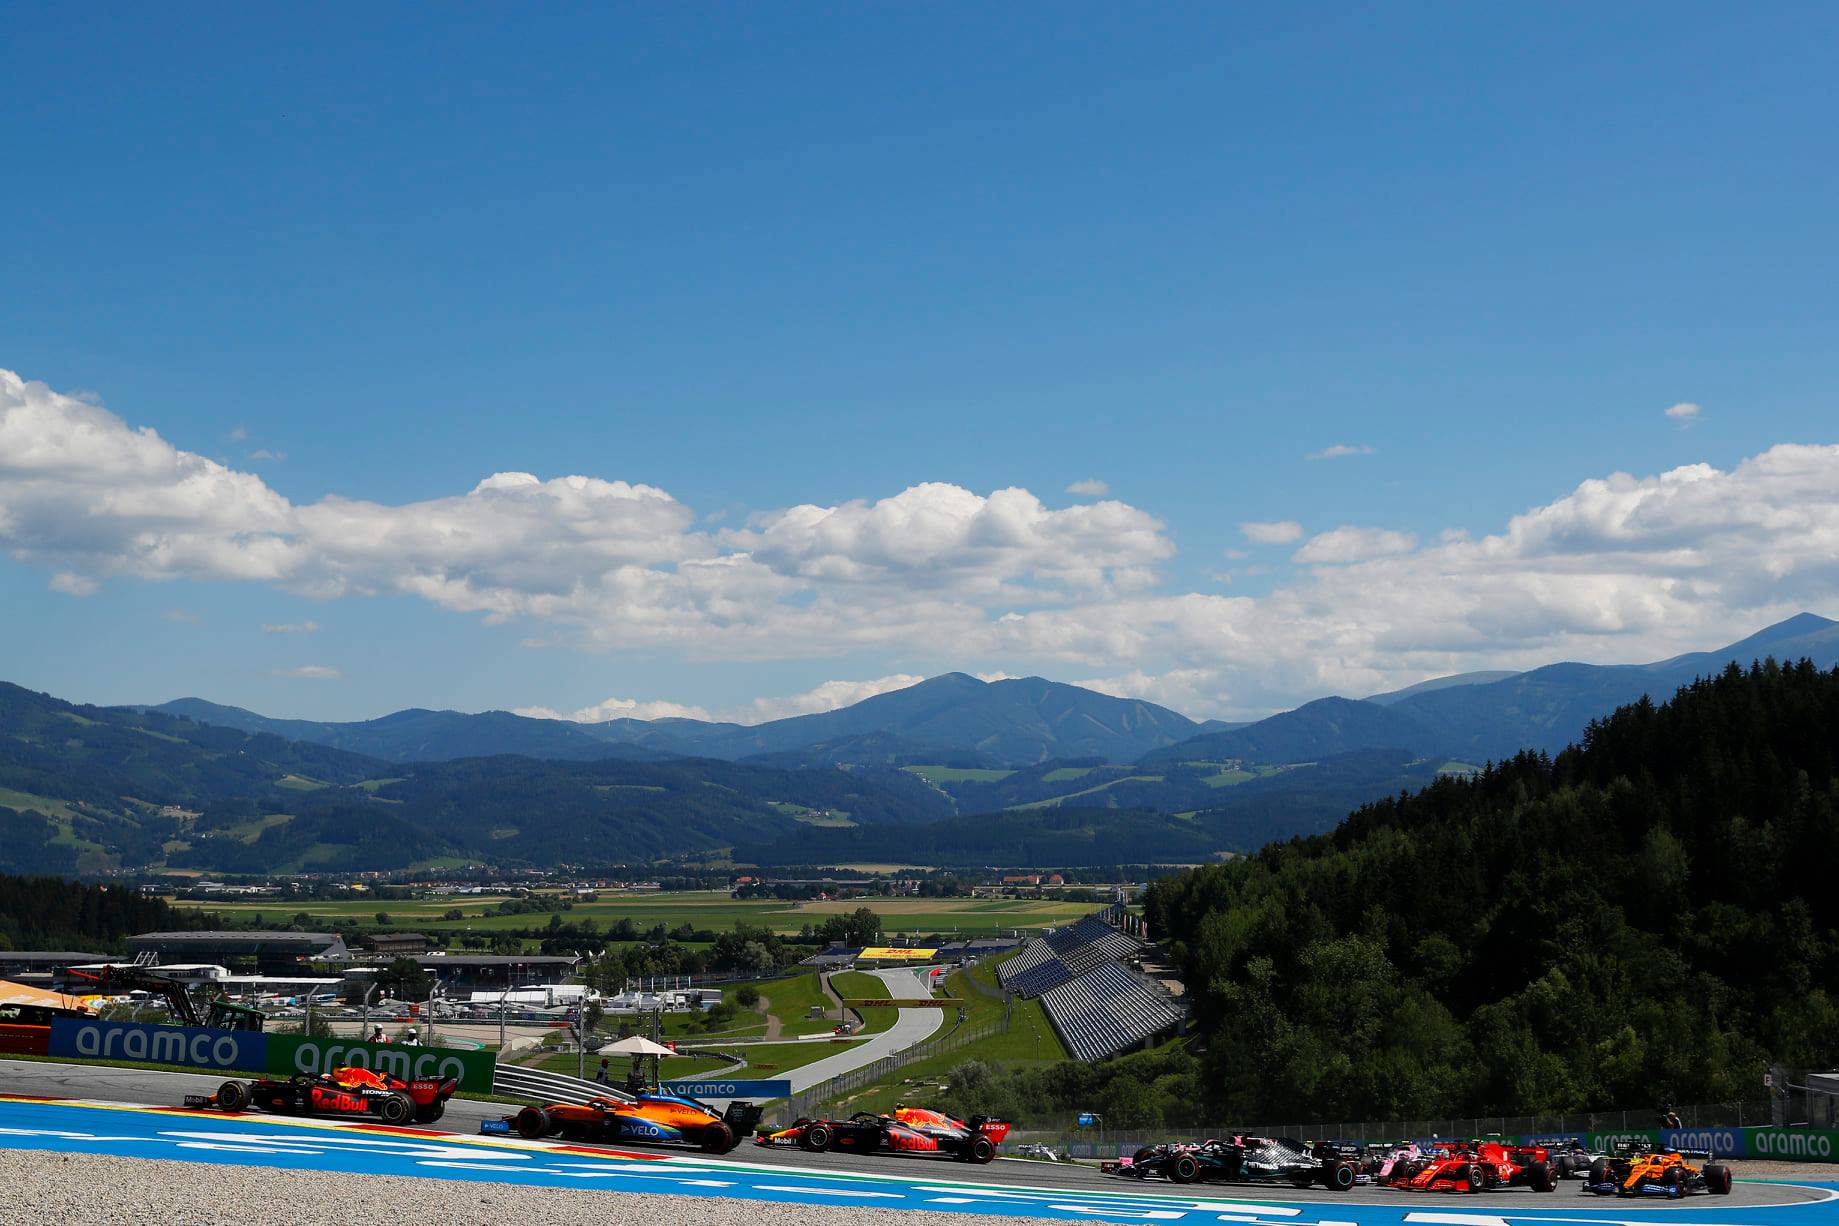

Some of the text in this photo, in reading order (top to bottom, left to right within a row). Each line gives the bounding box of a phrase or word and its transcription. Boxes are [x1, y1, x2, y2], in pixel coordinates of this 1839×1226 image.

[76, 1026, 239, 1066] aramco
[294, 1042, 465, 1084] aramco
[677, 1084, 736, 1095] aramco
[489, 1121, 504, 1129] VELO
[630, 1125, 659, 1136] VELO
[774, 1136, 792, 1144] Mobil
[1669, 1132, 1734, 1152] aramco
[1755, 1132, 1831, 1157] aramco
